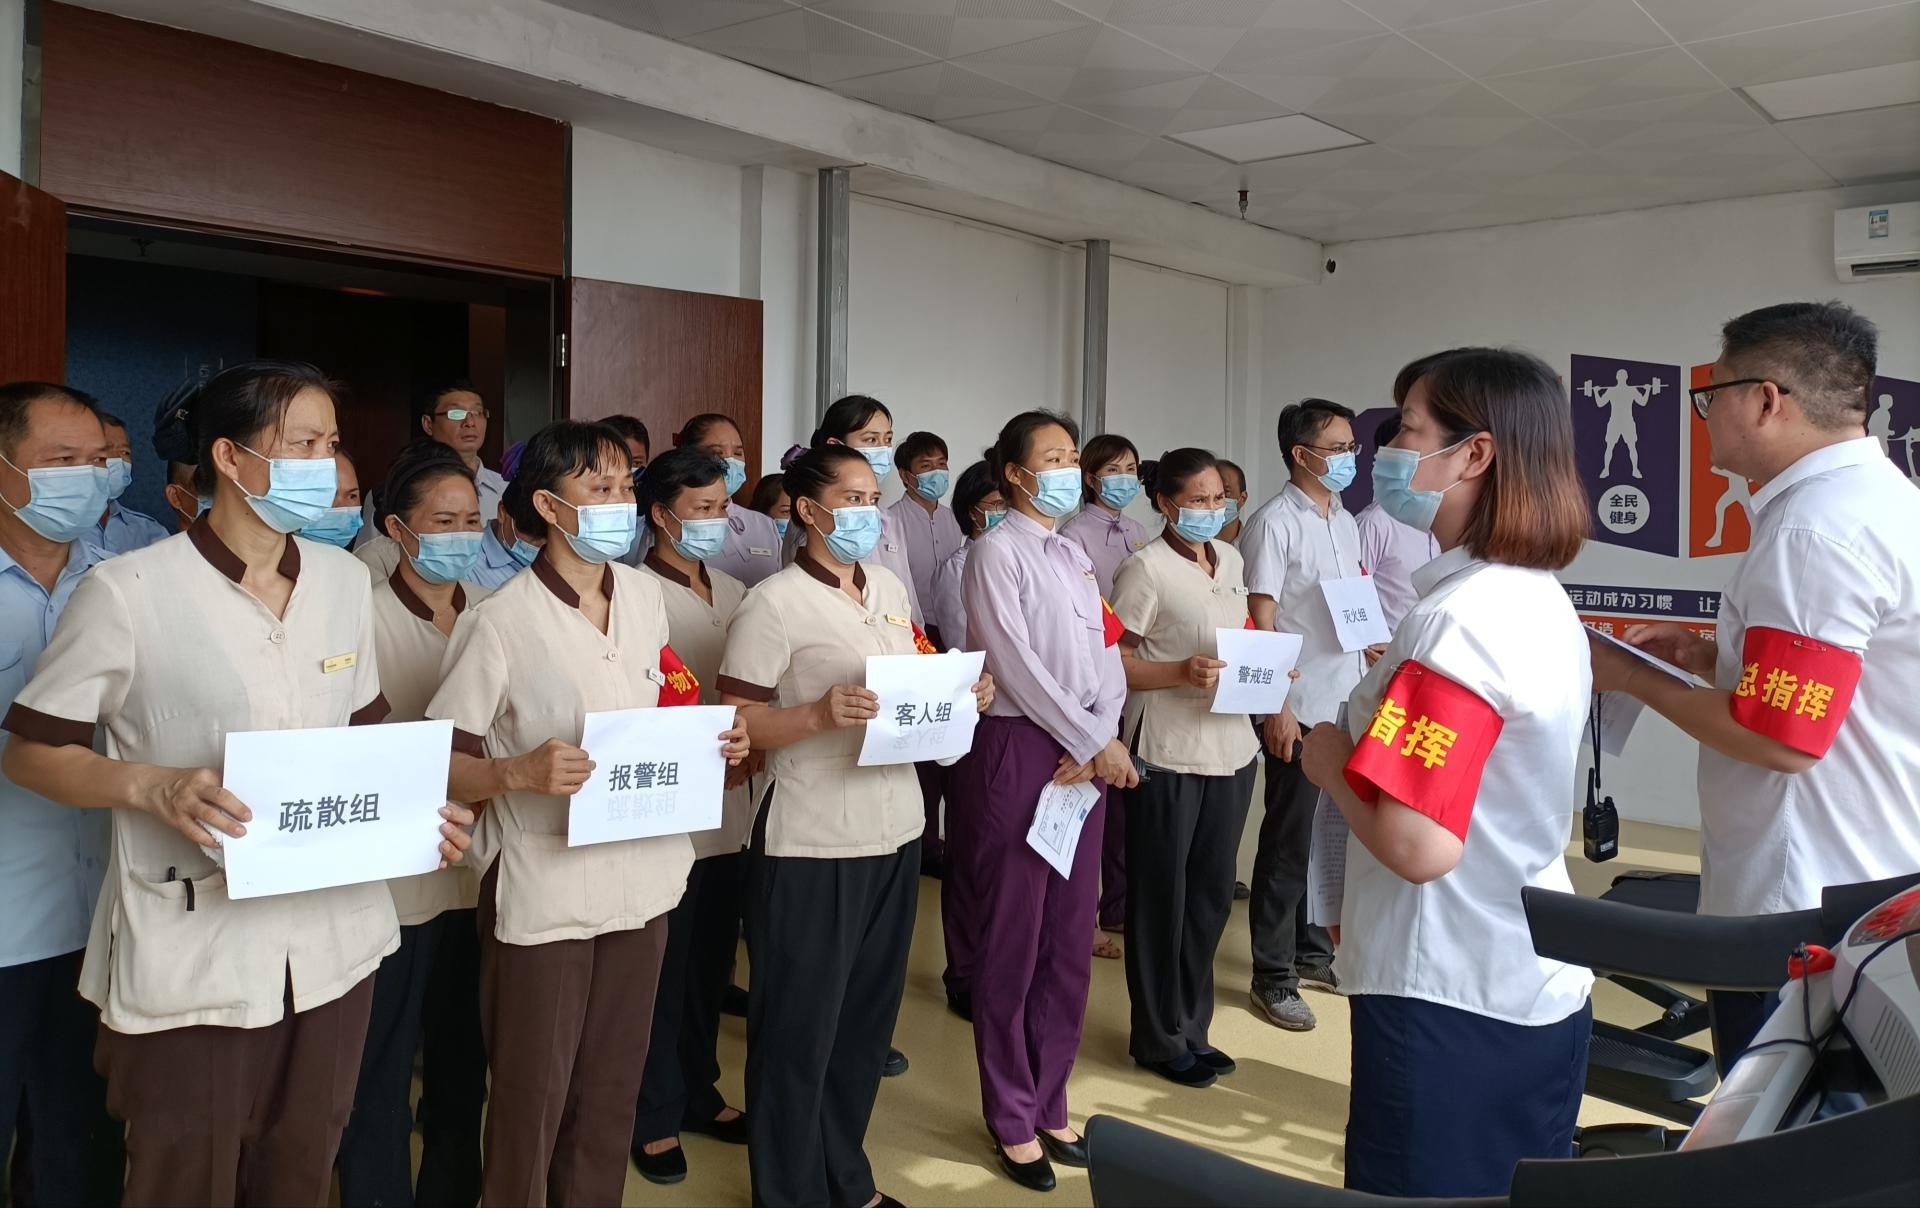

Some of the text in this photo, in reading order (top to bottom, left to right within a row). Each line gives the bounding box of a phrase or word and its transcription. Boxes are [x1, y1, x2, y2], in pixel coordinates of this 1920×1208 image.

[1609, 494, 1639, 508] 全民
[1609, 511, 1638, 525] 健身
[1569, 589, 1673, 611] 运动成为习惯
[1341, 607, 1368, 624] 灭火组
[1237, 664, 1274, 685] 警戒组
[1735, 662, 1835, 721] 总指挥
[894, 702, 953, 727] 客人组
[608, 761, 679, 792] 报警组
[277, 792, 381, 834] 疏散组
